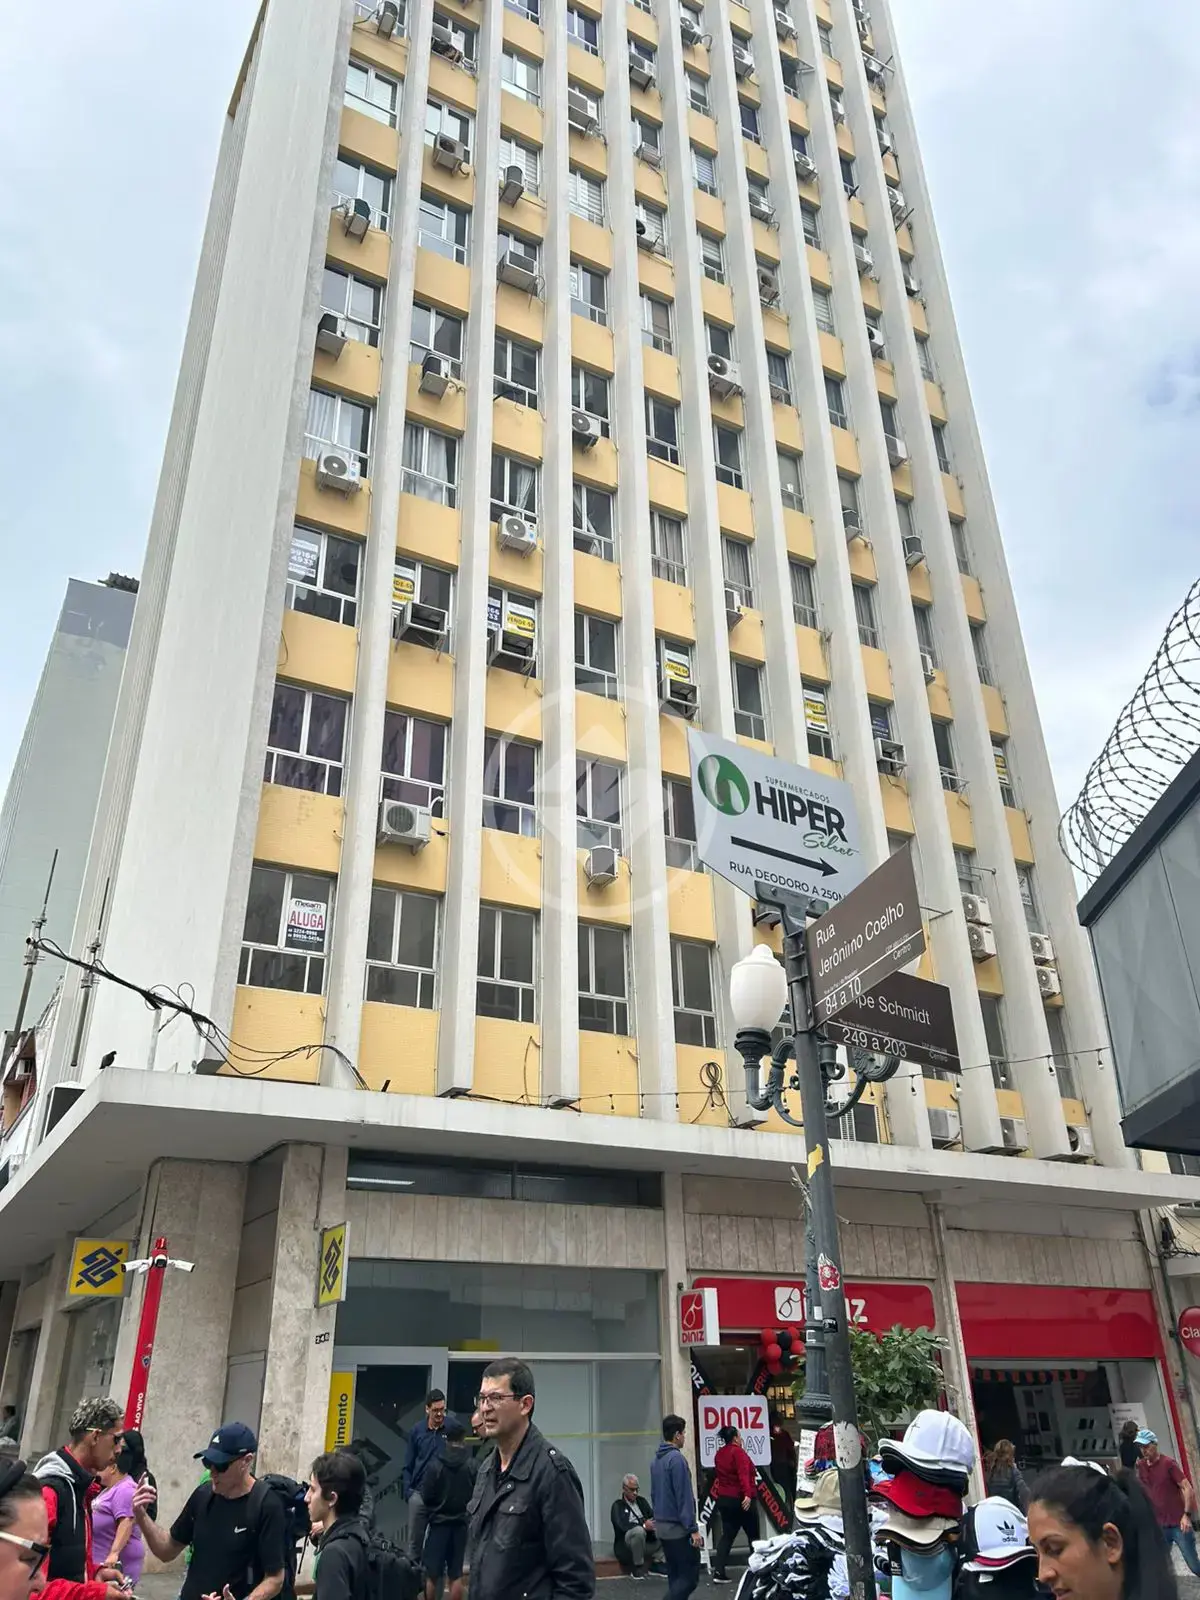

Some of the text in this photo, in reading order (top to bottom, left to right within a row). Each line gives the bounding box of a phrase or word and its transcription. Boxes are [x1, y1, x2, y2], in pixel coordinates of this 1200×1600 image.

[765, 775, 831, 804] SUPERMERCADOS
[753, 781, 848, 843] HIPER
[802, 831, 859, 857] Select
[729, 860, 753, 877] RUA
[755, 868, 810, 893] DEODORO
[812, 885, 820, 896] A
[290, 910, 324, 929] ALUGA
[865, 902, 904, 941] Coelho
[816, 923, 836, 948] Rua
[893, 943, 912, 961] Centro
[825, 994, 838, 1015] 84
[840, 991, 847, 1007] a
[849, 976, 861, 999] 10
[878, 995, 931, 1025] Schmidt
[842, 1027, 868, 1047] 249
[872, 1036, 881, 1051] a
[883, 1038, 907, 1058] 203
[682, 1330, 705, 1344] DINIZ
[1181, 1326, 1200, 1339] Cla
[136, 1392, 144, 1411] VIVO
[334, 1393, 349, 1448] imento
[704, 1406, 764, 1431] DINIZ
[757, 1482, 789, 1529] FRIDAY
